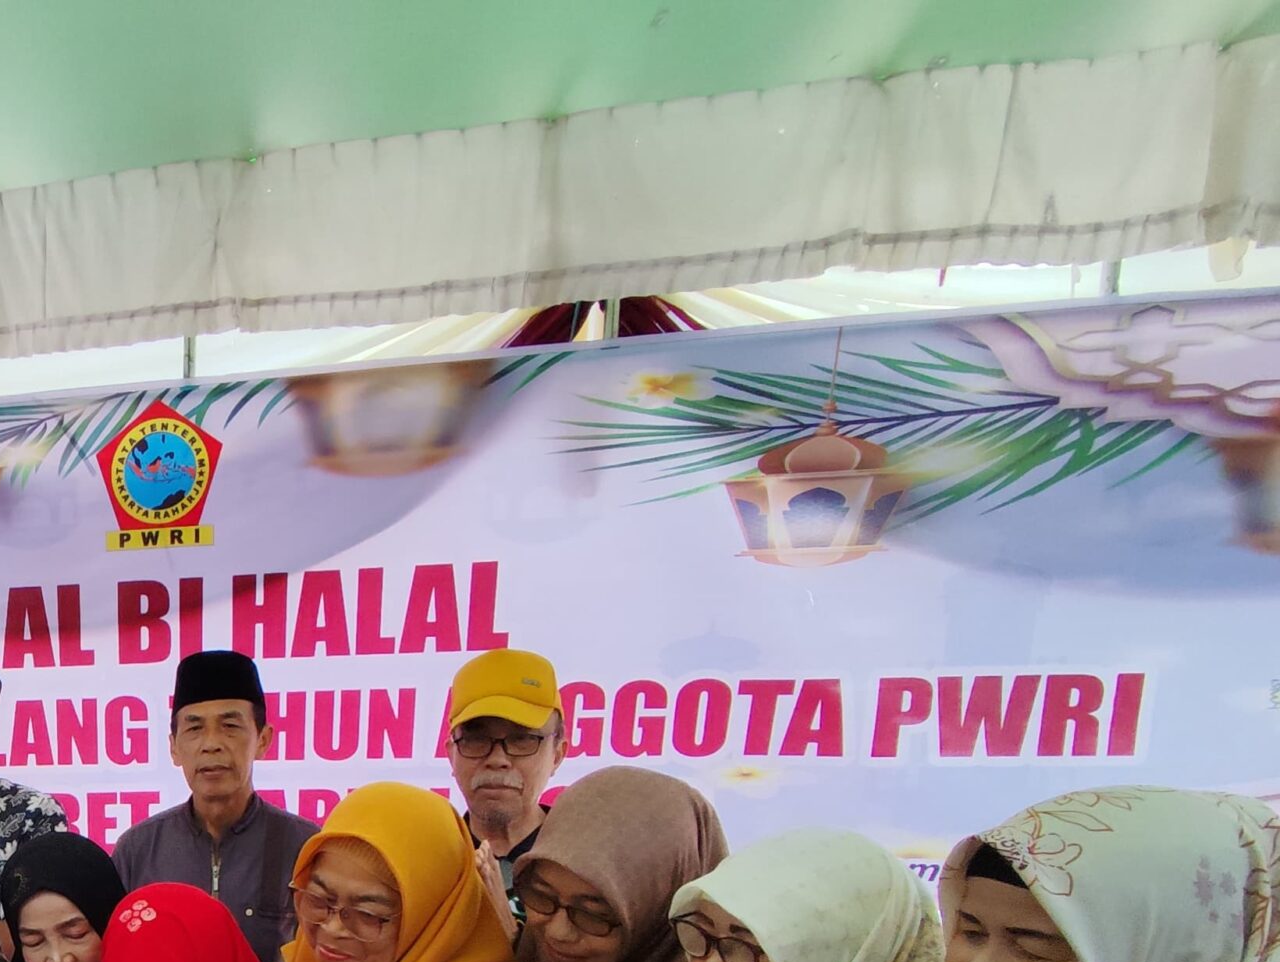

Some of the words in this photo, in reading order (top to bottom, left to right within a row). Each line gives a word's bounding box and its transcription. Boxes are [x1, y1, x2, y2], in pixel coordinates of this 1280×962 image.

[116, 437, 137, 475] TATA
[139, 422, 206, 468] TENTERAM
[117, 484, 150, 519] KARTA
[153, 479, 204, 520] RAHARJA
[119, 527, 200, 549] PWRI
[117, 577, 204, 665] BI
[231, 561, 509, 660] HALAL
[870, 672, 1146, 759] PWRI
